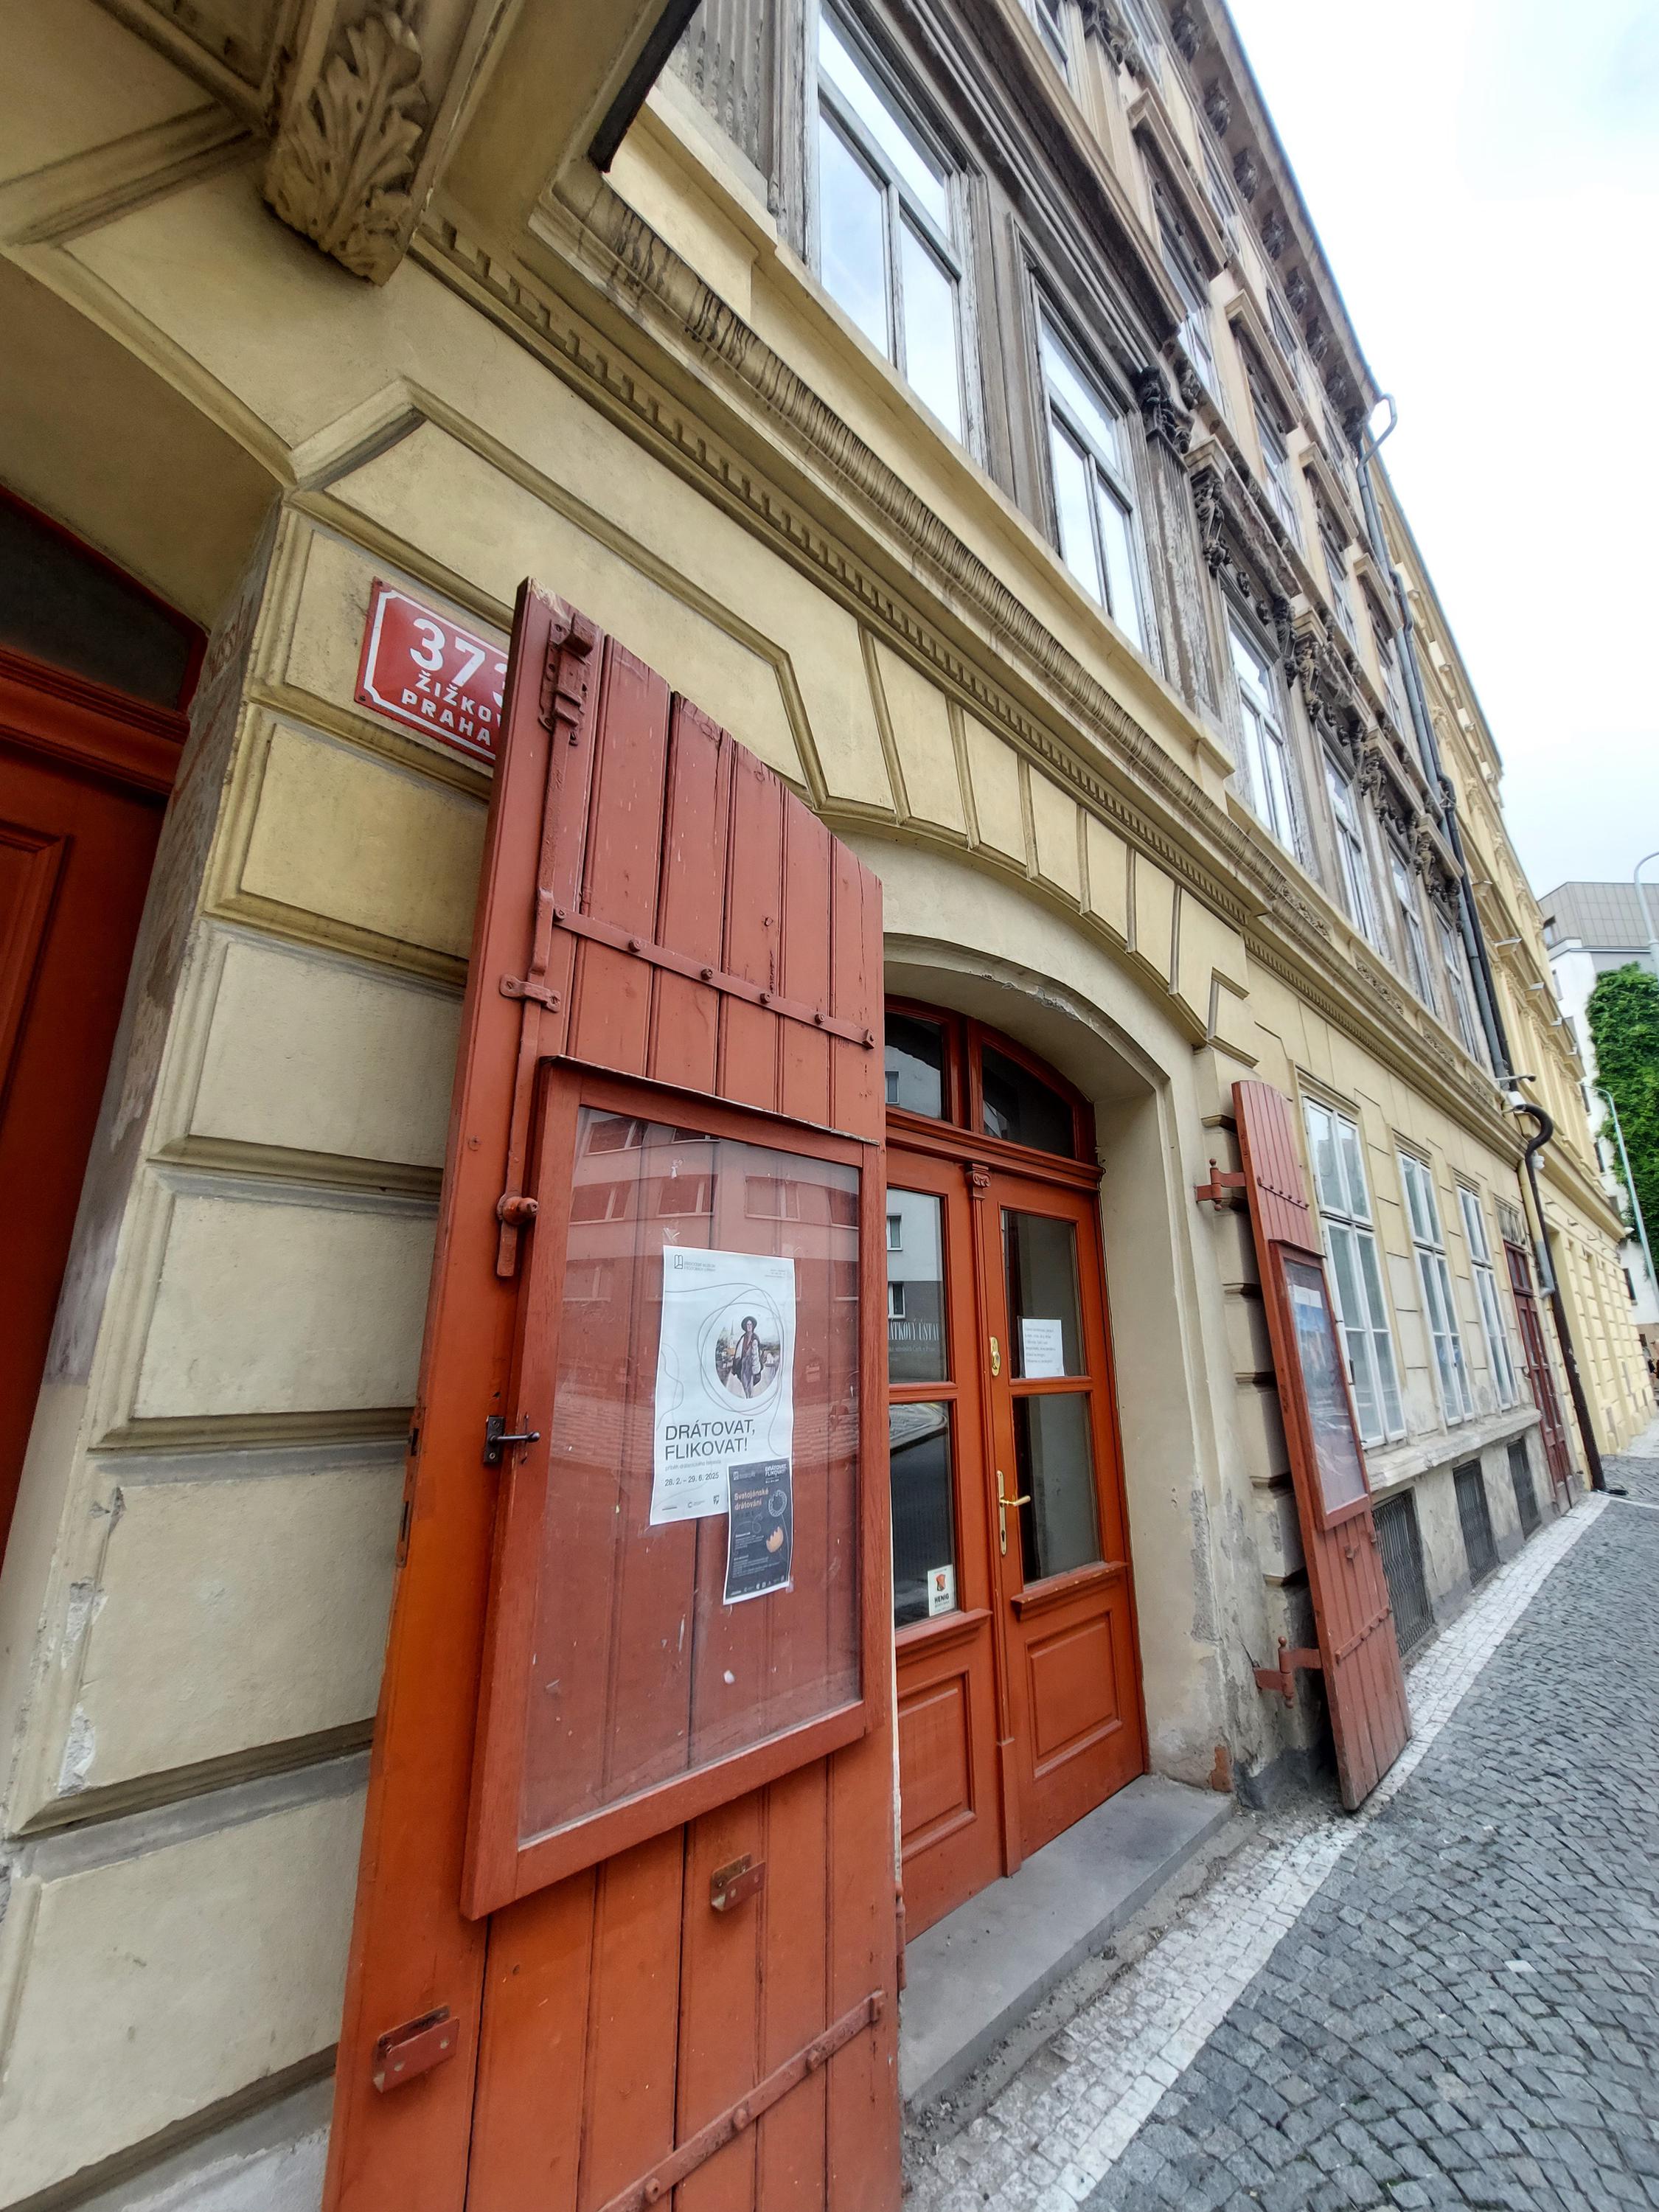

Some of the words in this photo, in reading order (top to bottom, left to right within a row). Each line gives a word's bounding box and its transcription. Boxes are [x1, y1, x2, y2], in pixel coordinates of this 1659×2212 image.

[401, 689, 491, 746] PRAHA
[666, 1419, 755, 1441] DRÁTOVAT,
[666, 1437, 748, 1461] FLIKOVAT!
[705, 1472, 720, 1481] 2025
[934, 1593, 950, 1604] HENIG
